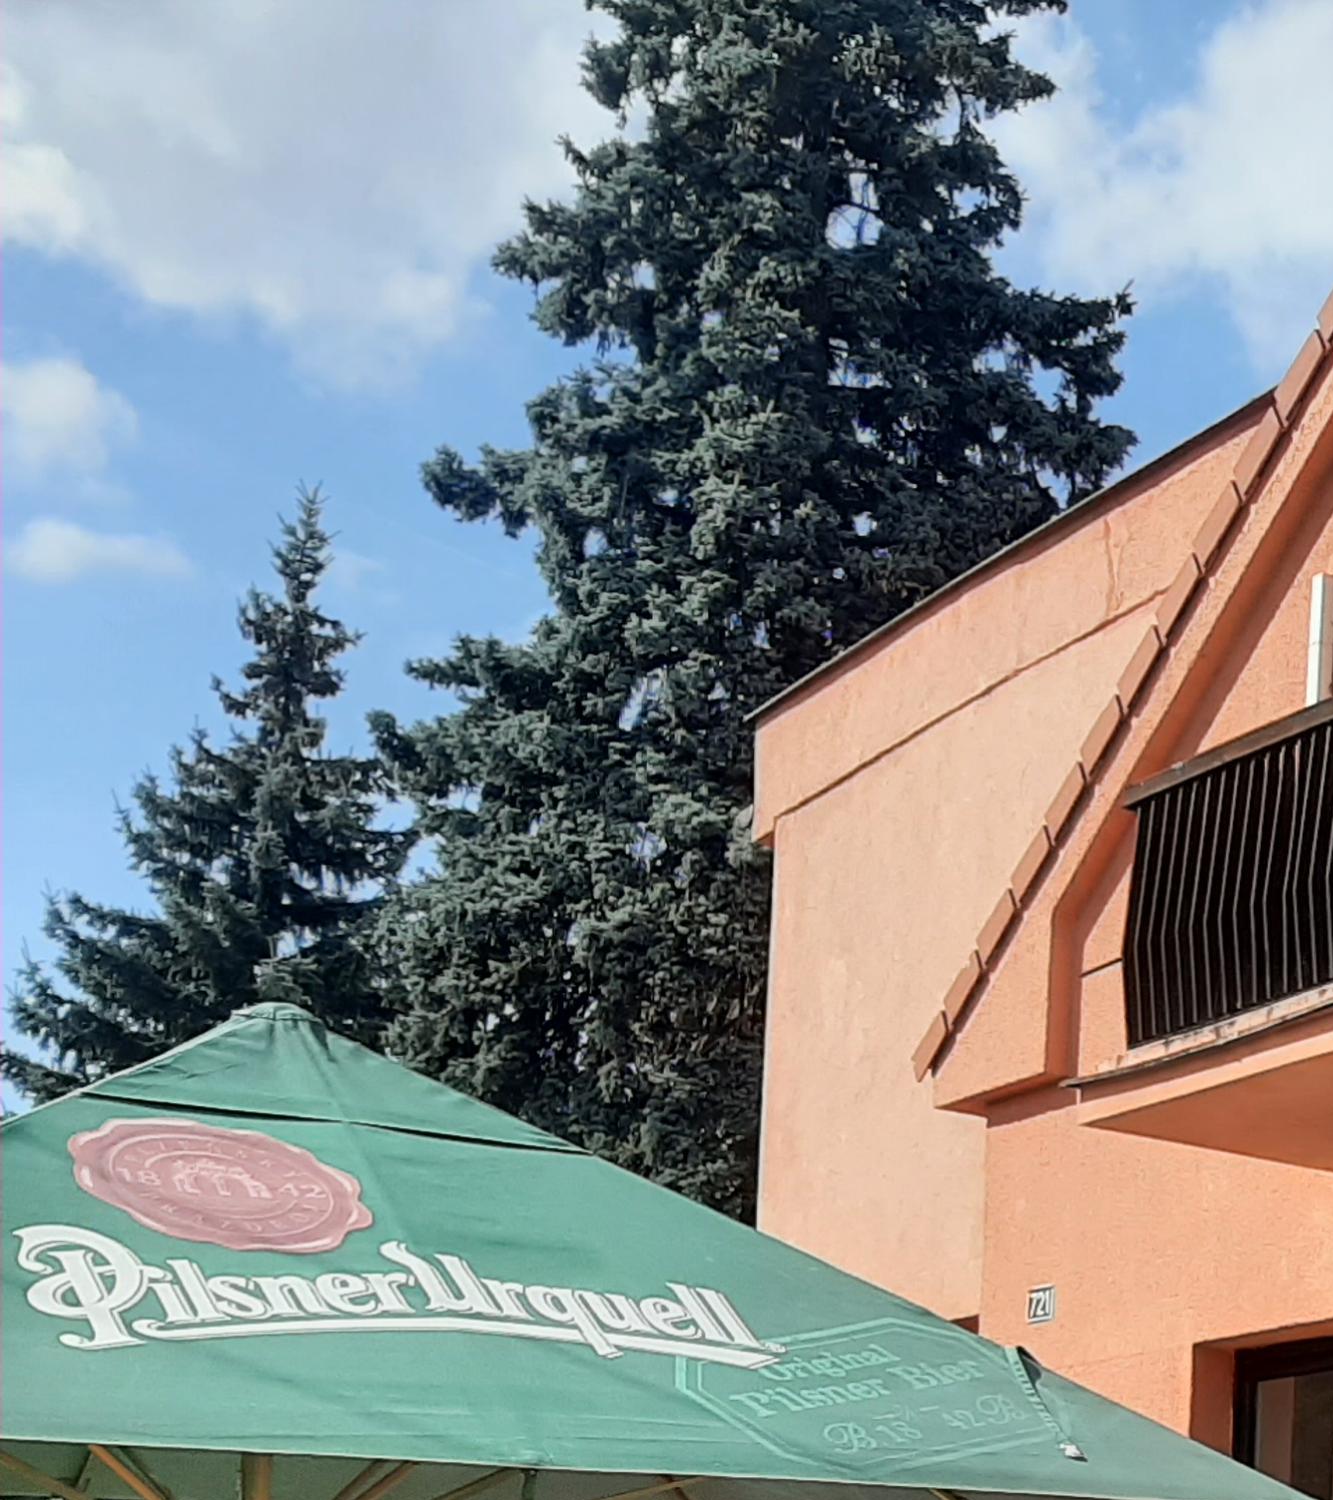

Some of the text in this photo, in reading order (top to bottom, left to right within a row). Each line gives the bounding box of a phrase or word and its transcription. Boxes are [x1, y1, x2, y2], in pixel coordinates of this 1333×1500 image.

[13, 1224, 770, 1359] Pilsner Urquell
[1030, 1289, 1050, 1318] 721
[757, 1343, 900, 1381] Original
[729, 1359, 985, 1417] Pilsner Bier
